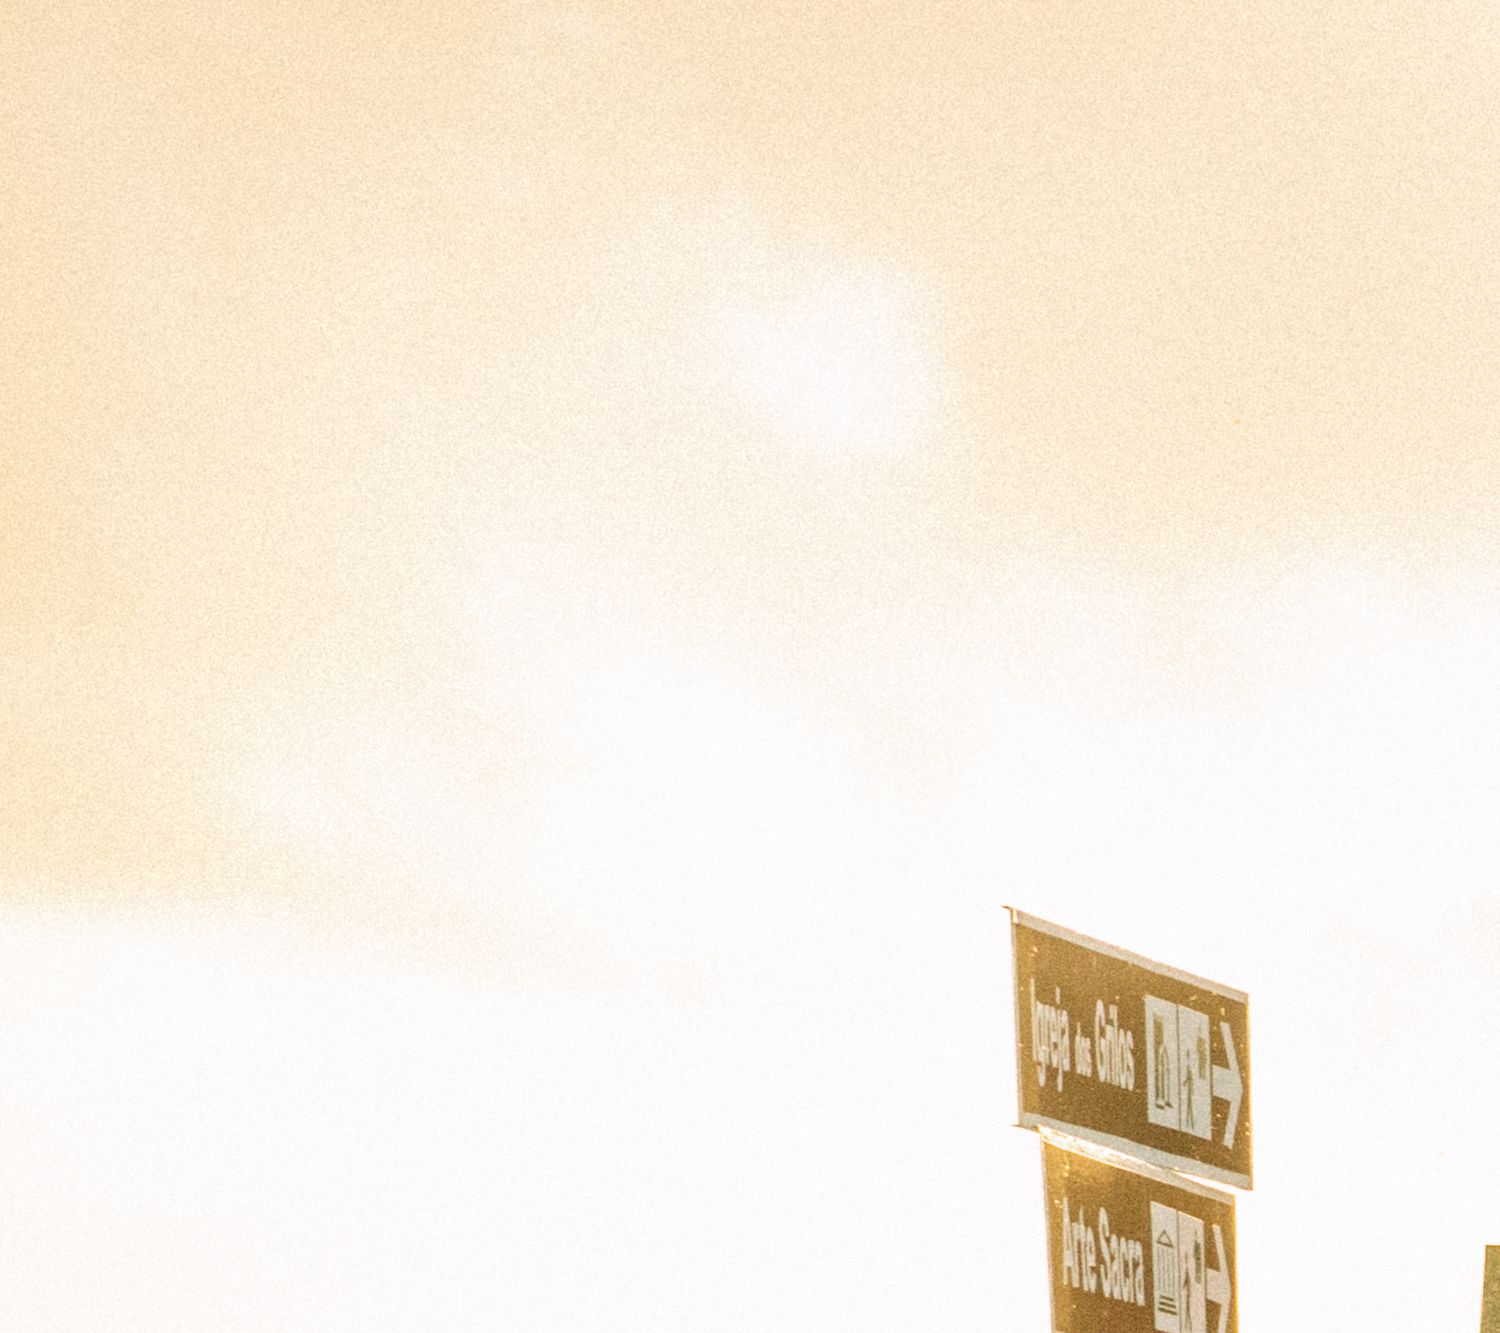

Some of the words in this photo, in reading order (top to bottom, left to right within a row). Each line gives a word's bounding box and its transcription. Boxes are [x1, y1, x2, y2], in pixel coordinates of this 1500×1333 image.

[1030, 976, 1071, 1093] Igreja
[1074, 1021, 1092, 1077] dos
[1095, 998, 1135, 1092] Grilos
[1062, 1195, 1097, 1294] Arte
[1098, 1206, 1146, 1307] Sacra
